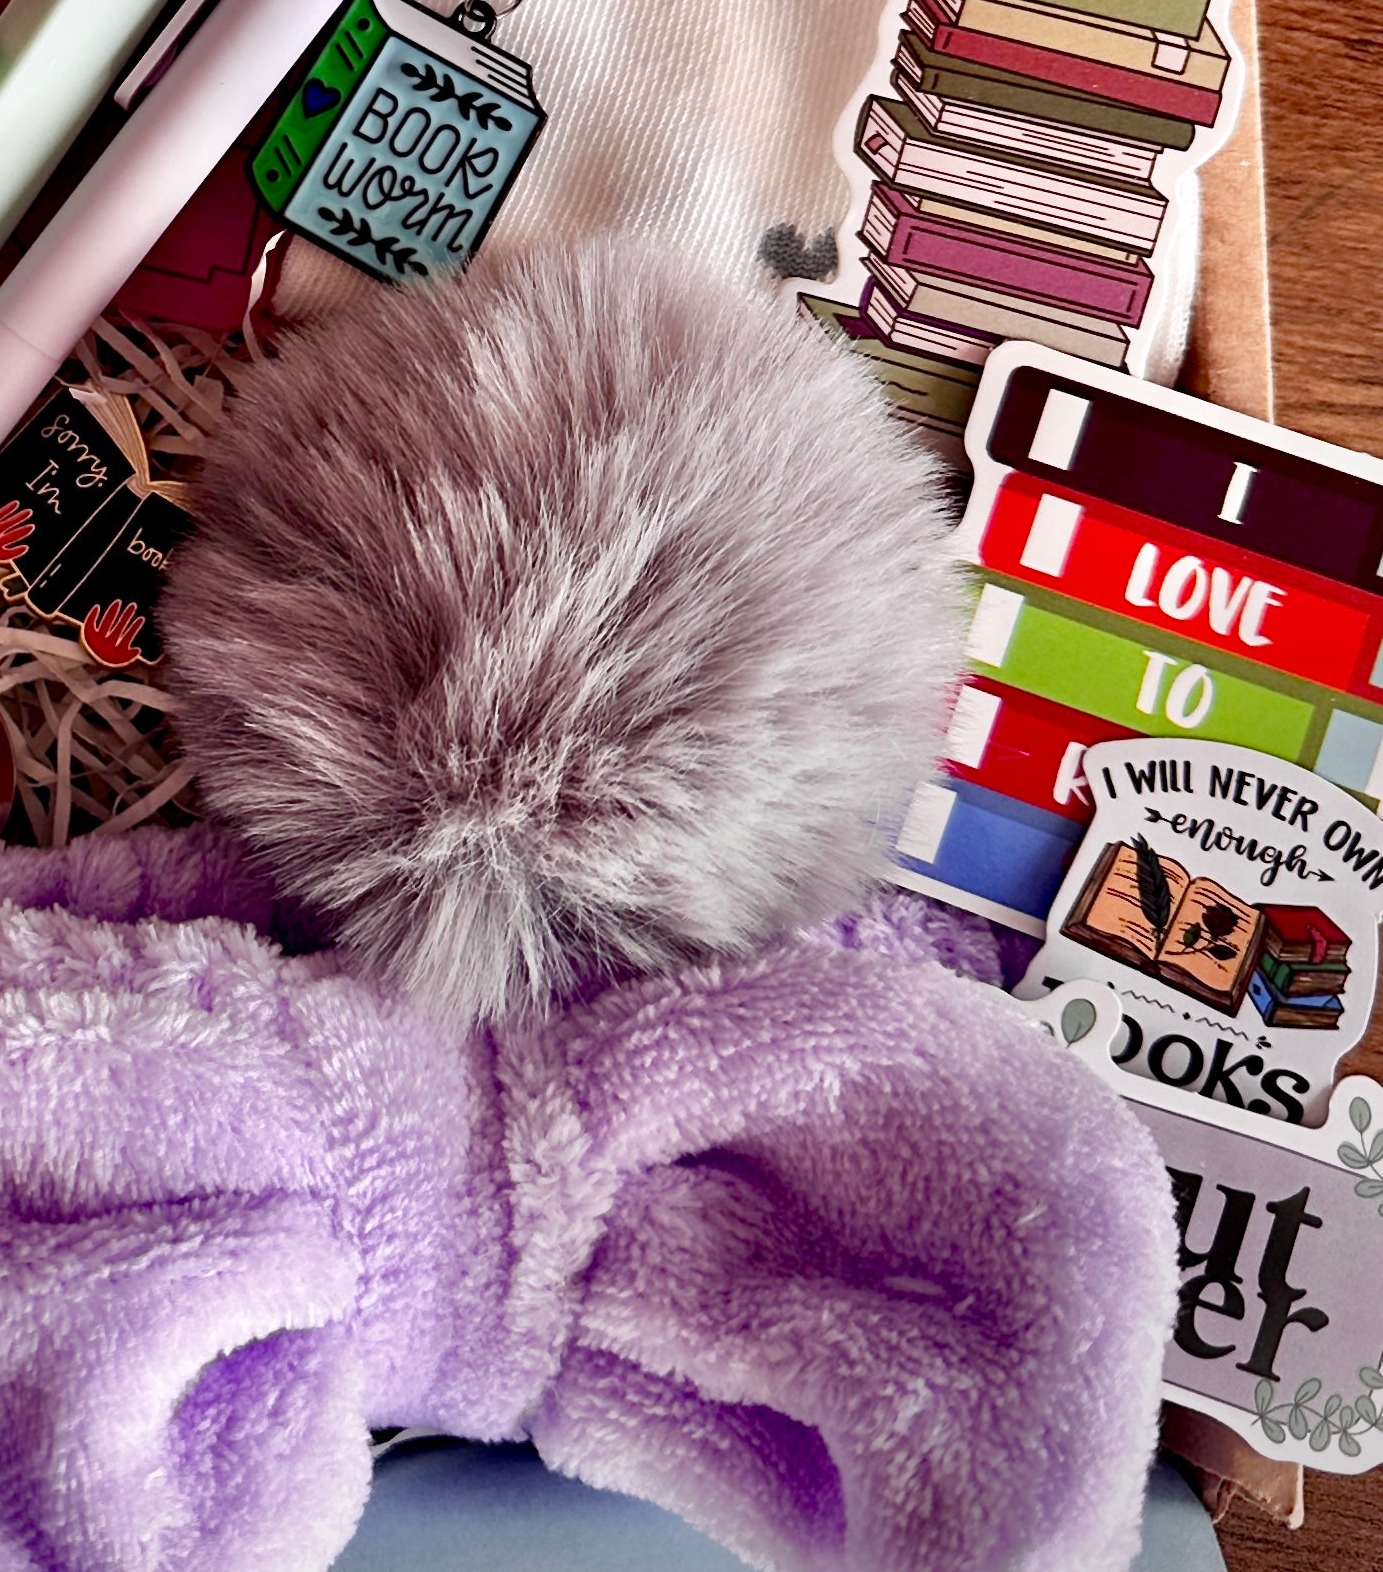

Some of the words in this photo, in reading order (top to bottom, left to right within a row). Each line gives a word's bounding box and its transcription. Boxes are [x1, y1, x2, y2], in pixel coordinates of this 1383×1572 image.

[353, 86, 499, 199] BOOK
[1217, 461, 1258, 525] I
[1124, 541, 1287, 647] LOVE
[1135, 649, 1214, 729] TO
[1101, 766, 1117, 799] I
[1123, 759, 1194, 795] WILL
[1209, 763, 1320, 833] NEVER
[1322, 819, 1383, 891] OWN
[1170, 812, 1309, 887] enough
[1164, 1165, 1323, 1302] ut
[1173, 1273, 1330, 1383] er
